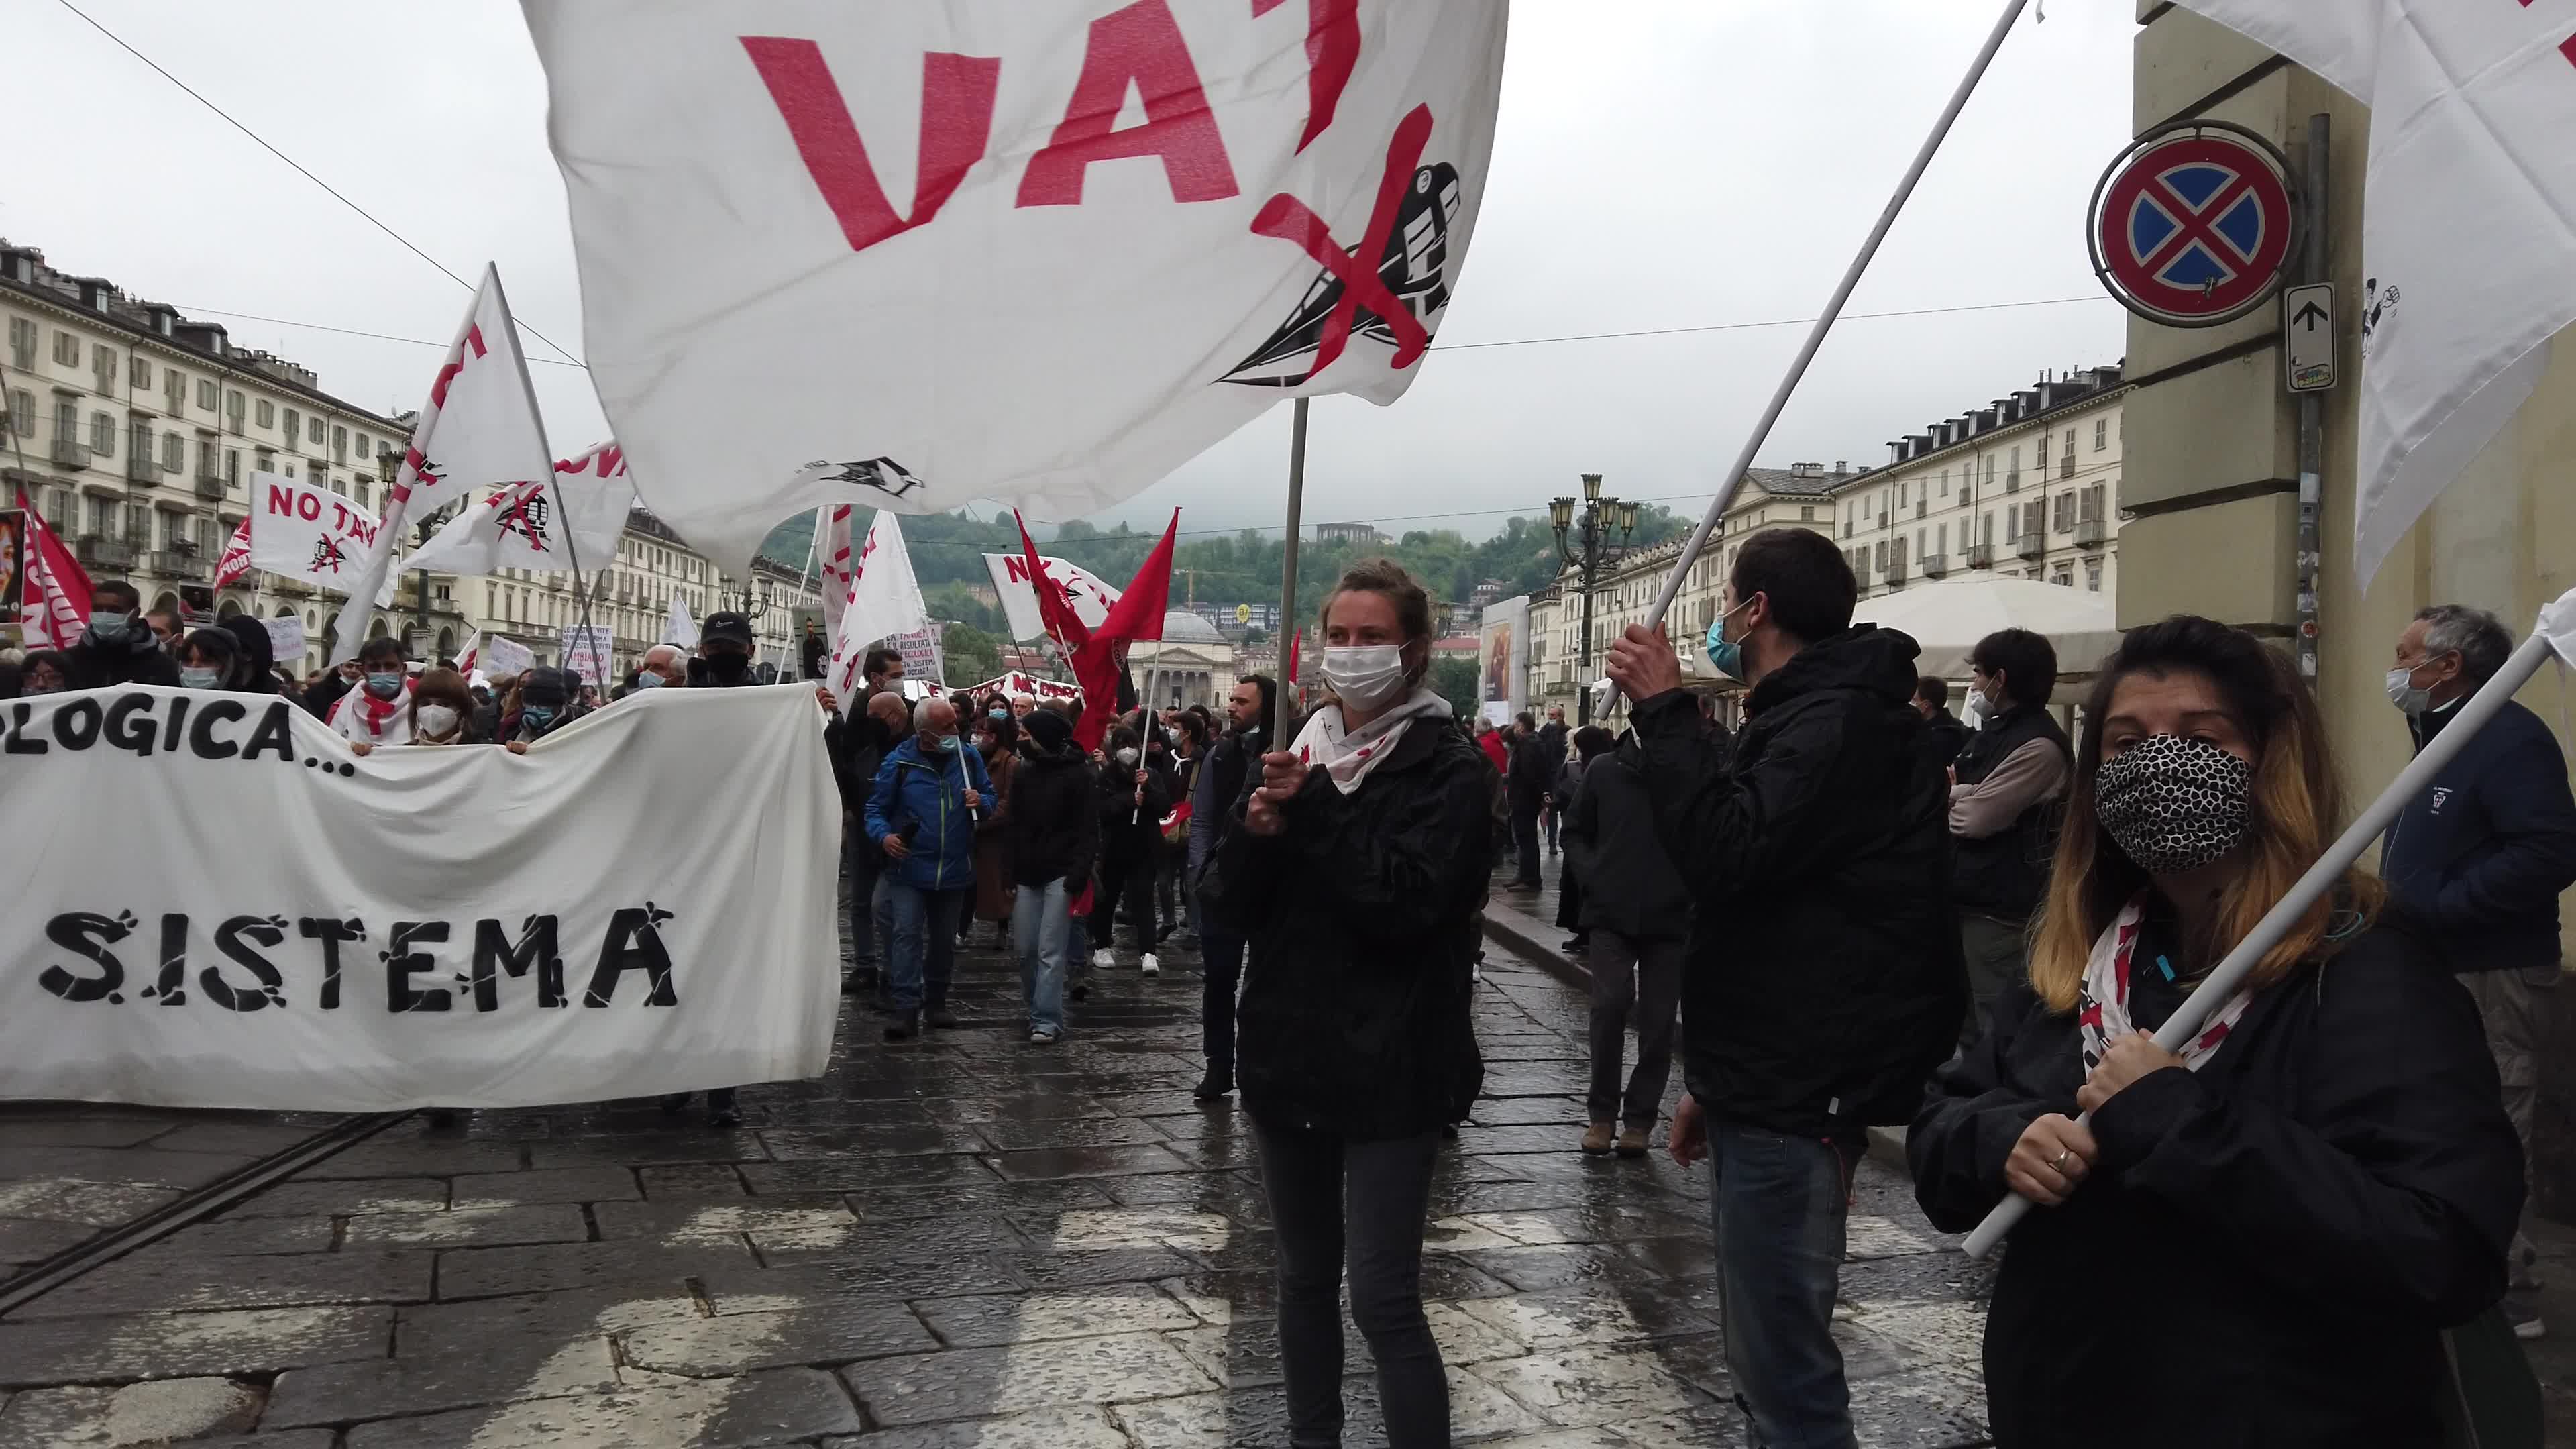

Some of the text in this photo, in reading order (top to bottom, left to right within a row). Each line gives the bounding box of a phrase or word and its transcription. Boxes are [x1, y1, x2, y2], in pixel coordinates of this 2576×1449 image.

[269, 484, 378, 549] NO TAV
[37, 900, 678, 1014] SISTEMA
